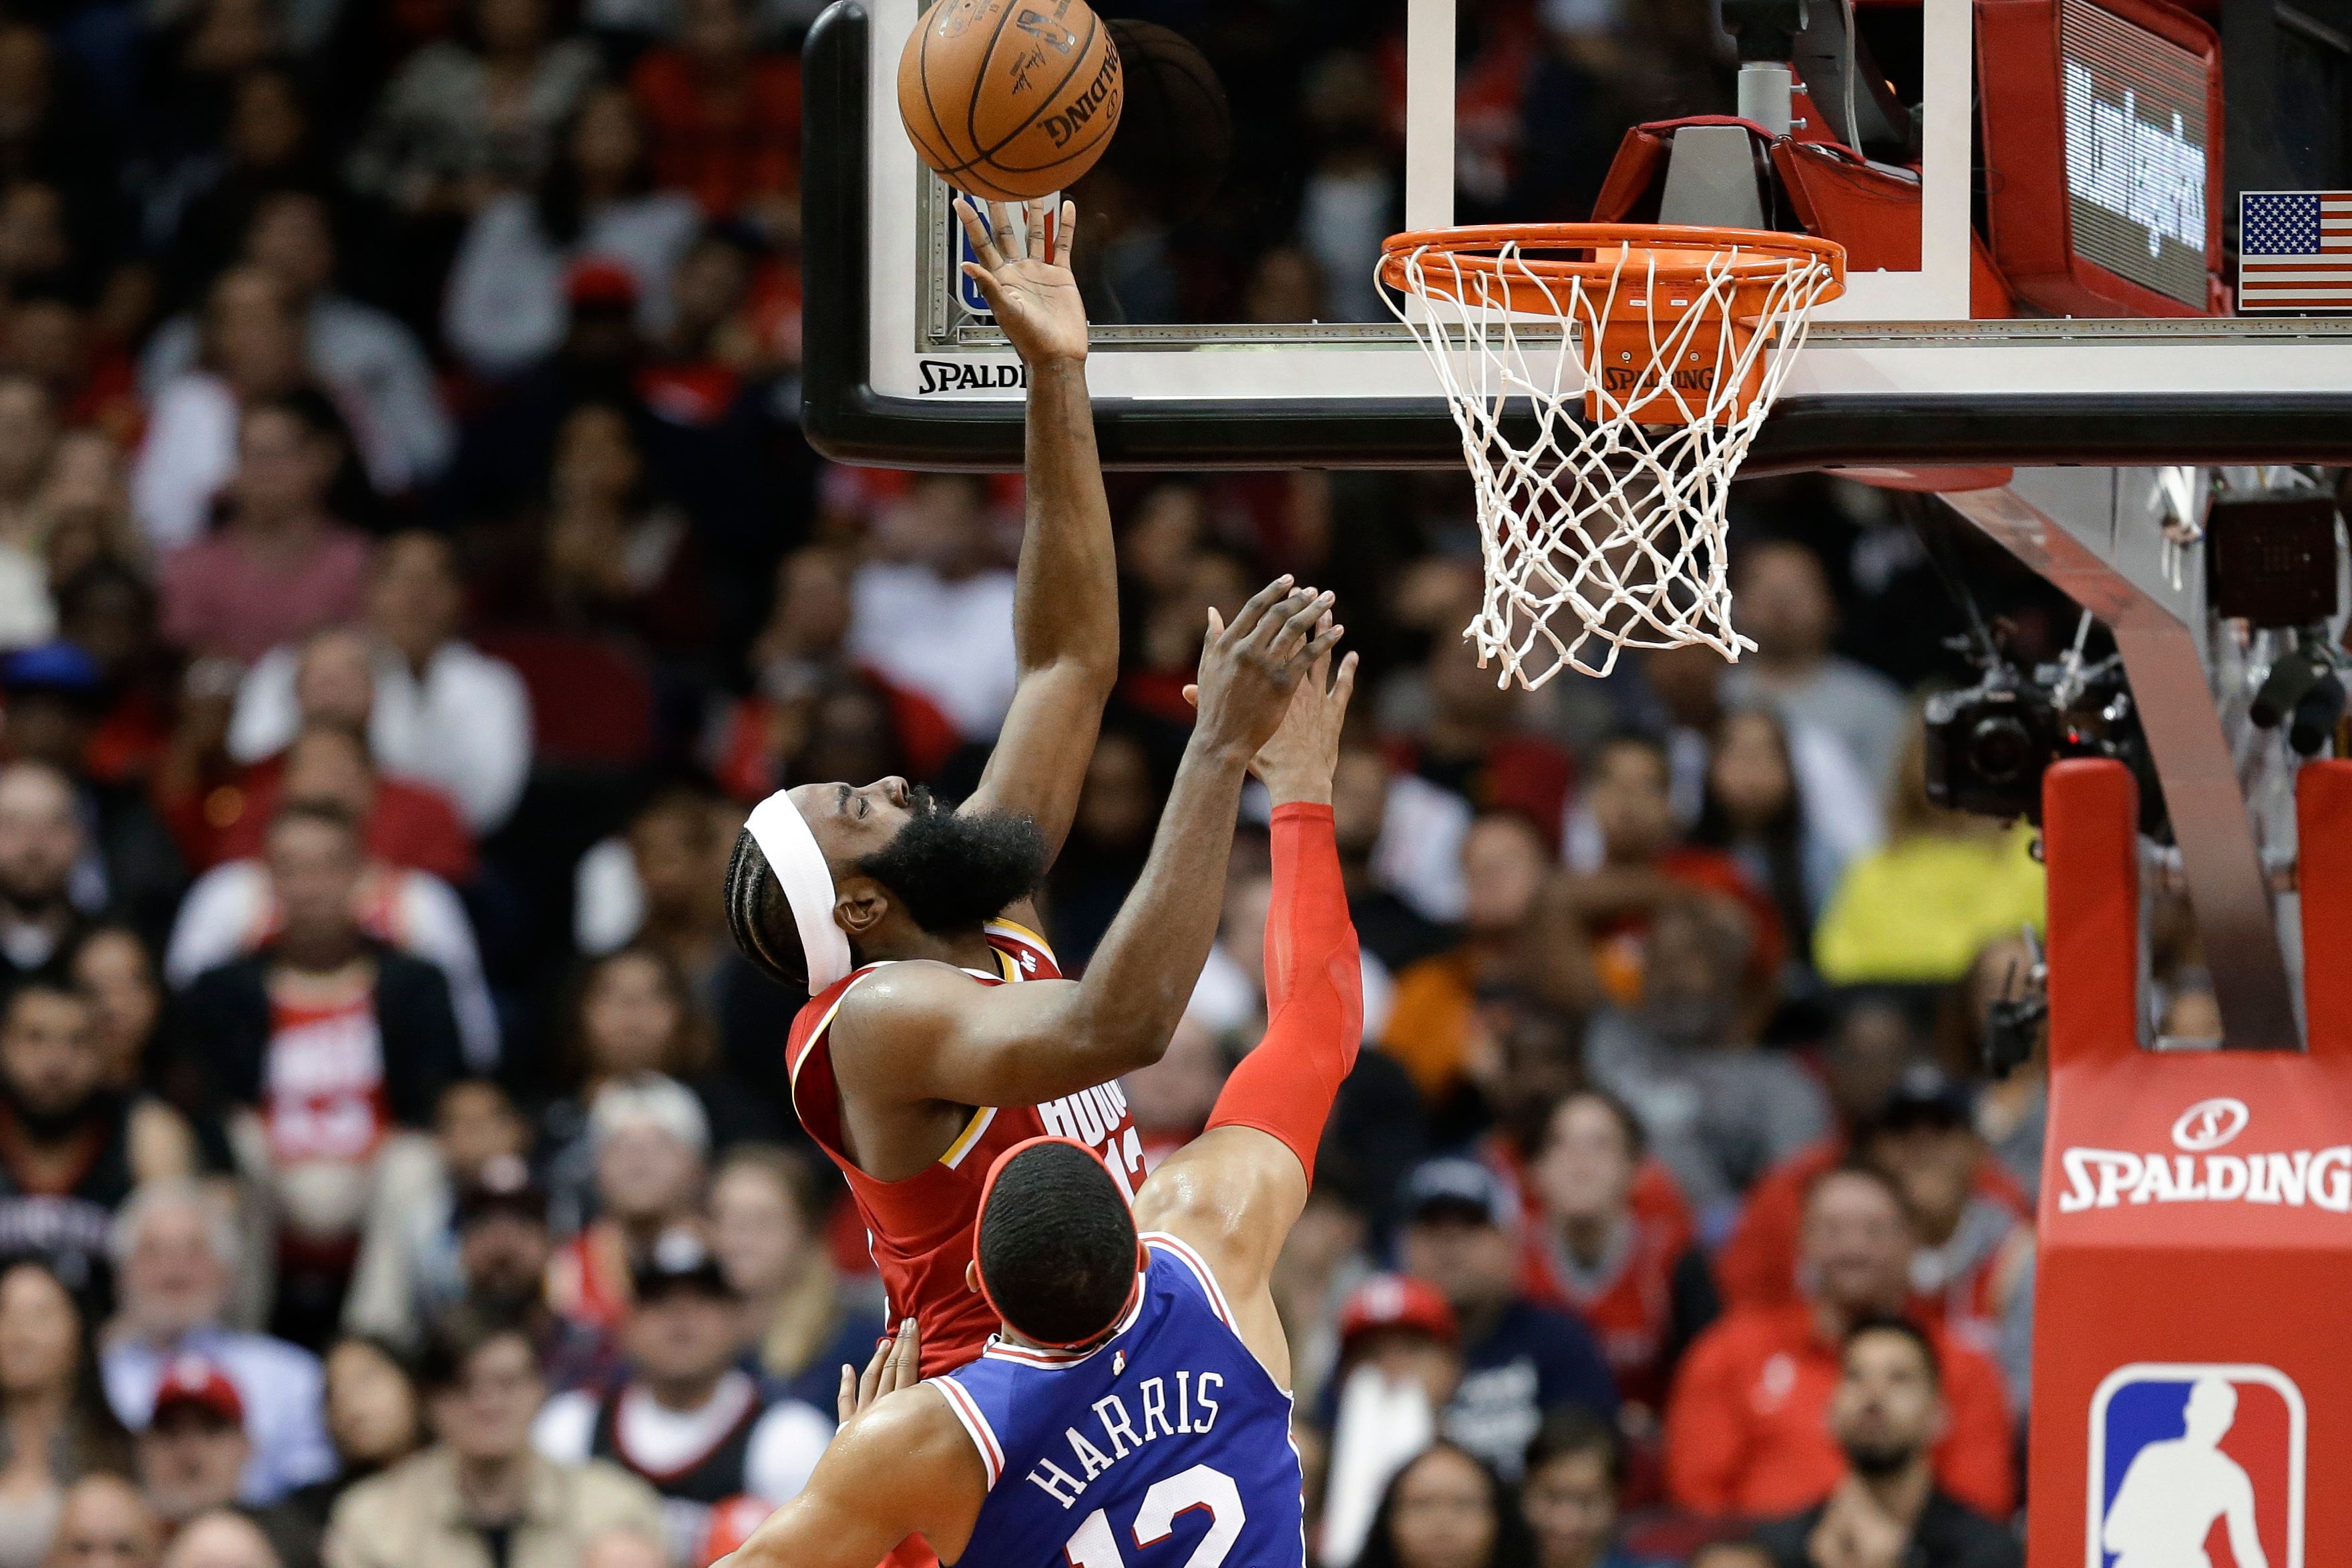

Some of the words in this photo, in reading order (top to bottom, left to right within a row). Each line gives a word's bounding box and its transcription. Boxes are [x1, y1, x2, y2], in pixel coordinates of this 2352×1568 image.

[919, 360, 1027, 394] SPALDI
[1606, 367, 1714, 391] SPALING
[2059, 1146, 2352, 1213] SPALDING
[1026, 1371, 1223, 1509] HARRIS
